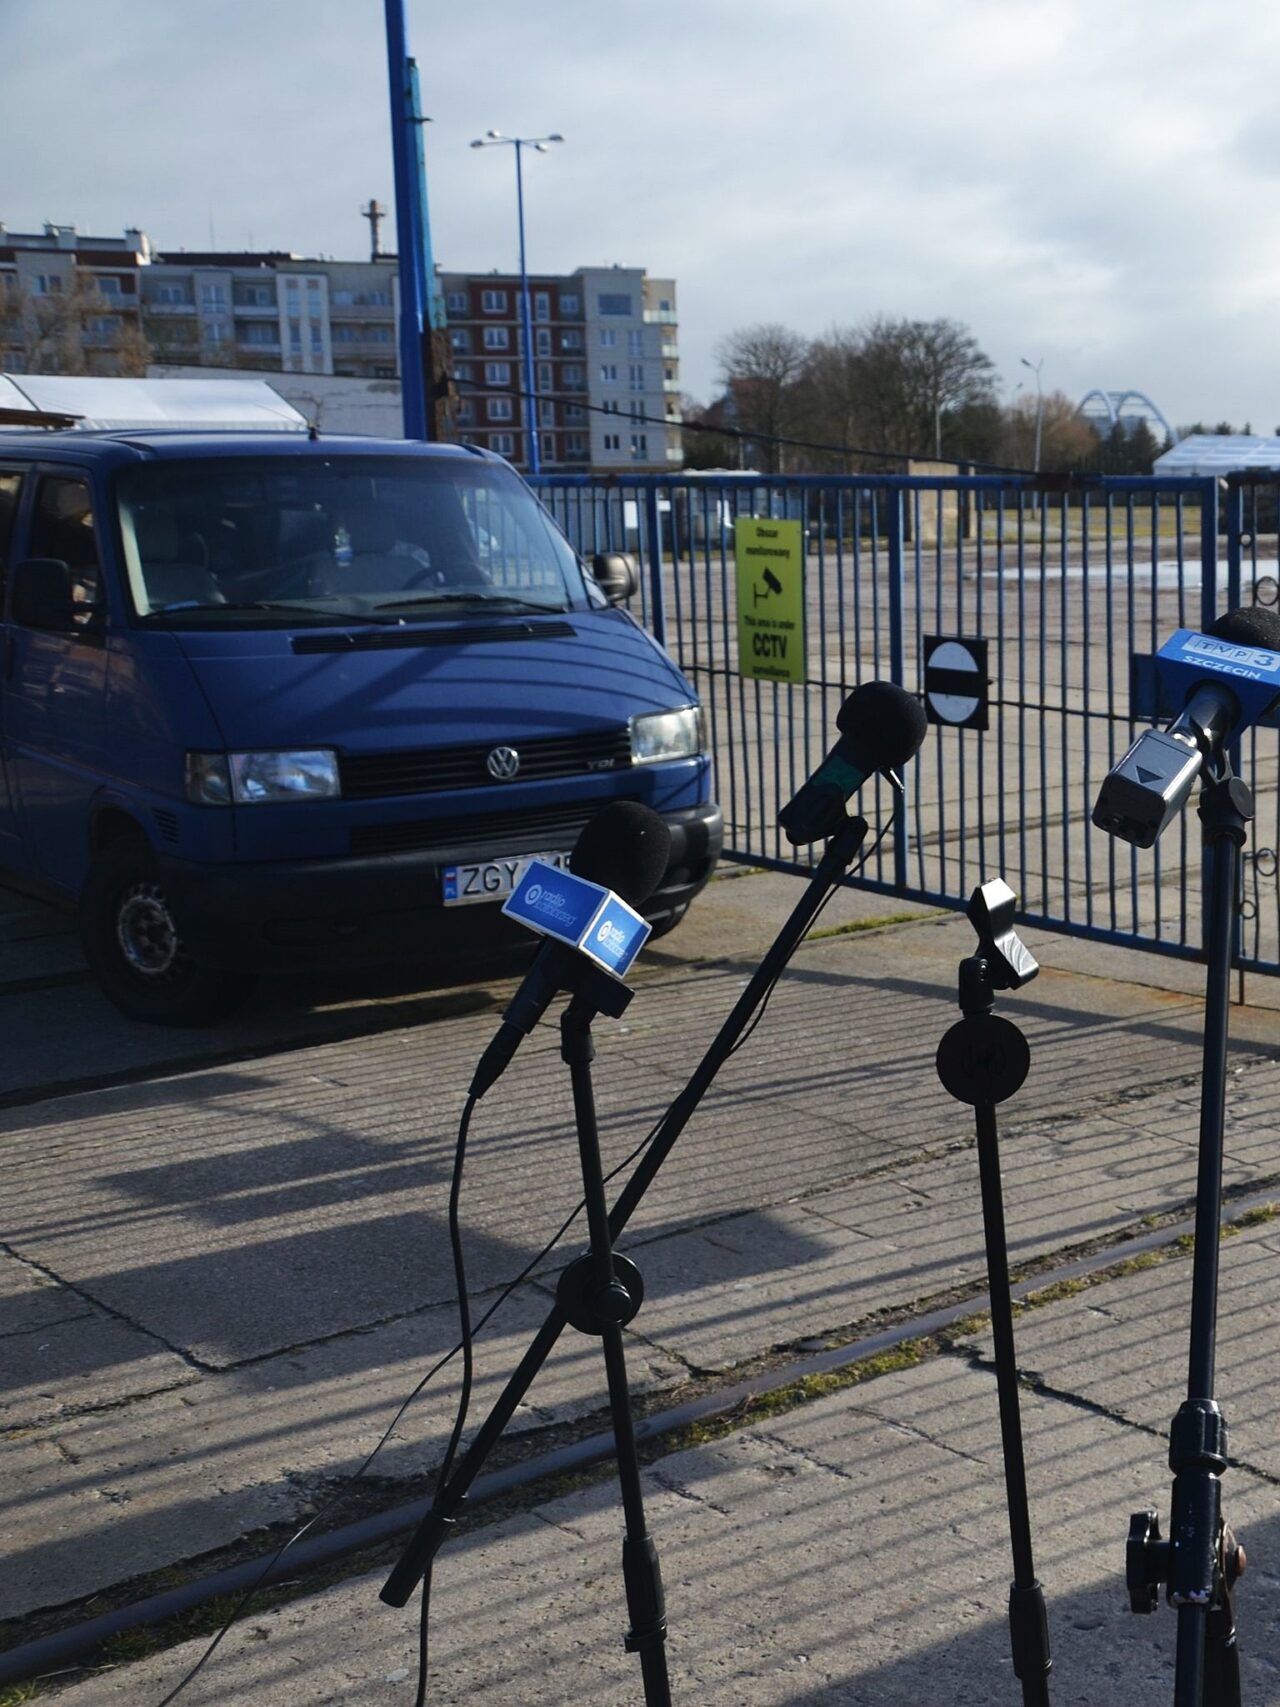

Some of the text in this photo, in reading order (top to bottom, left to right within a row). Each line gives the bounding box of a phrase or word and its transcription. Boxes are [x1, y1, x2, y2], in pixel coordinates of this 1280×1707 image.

[752, 631, 787, 659] CCTV
[1200, 640, 1248, 659] TVP
[1182, 655, 1262, 680] SZCZECIN
[461, 861, 519, 896] ZGY
[541, 890, 567, 907] radio
